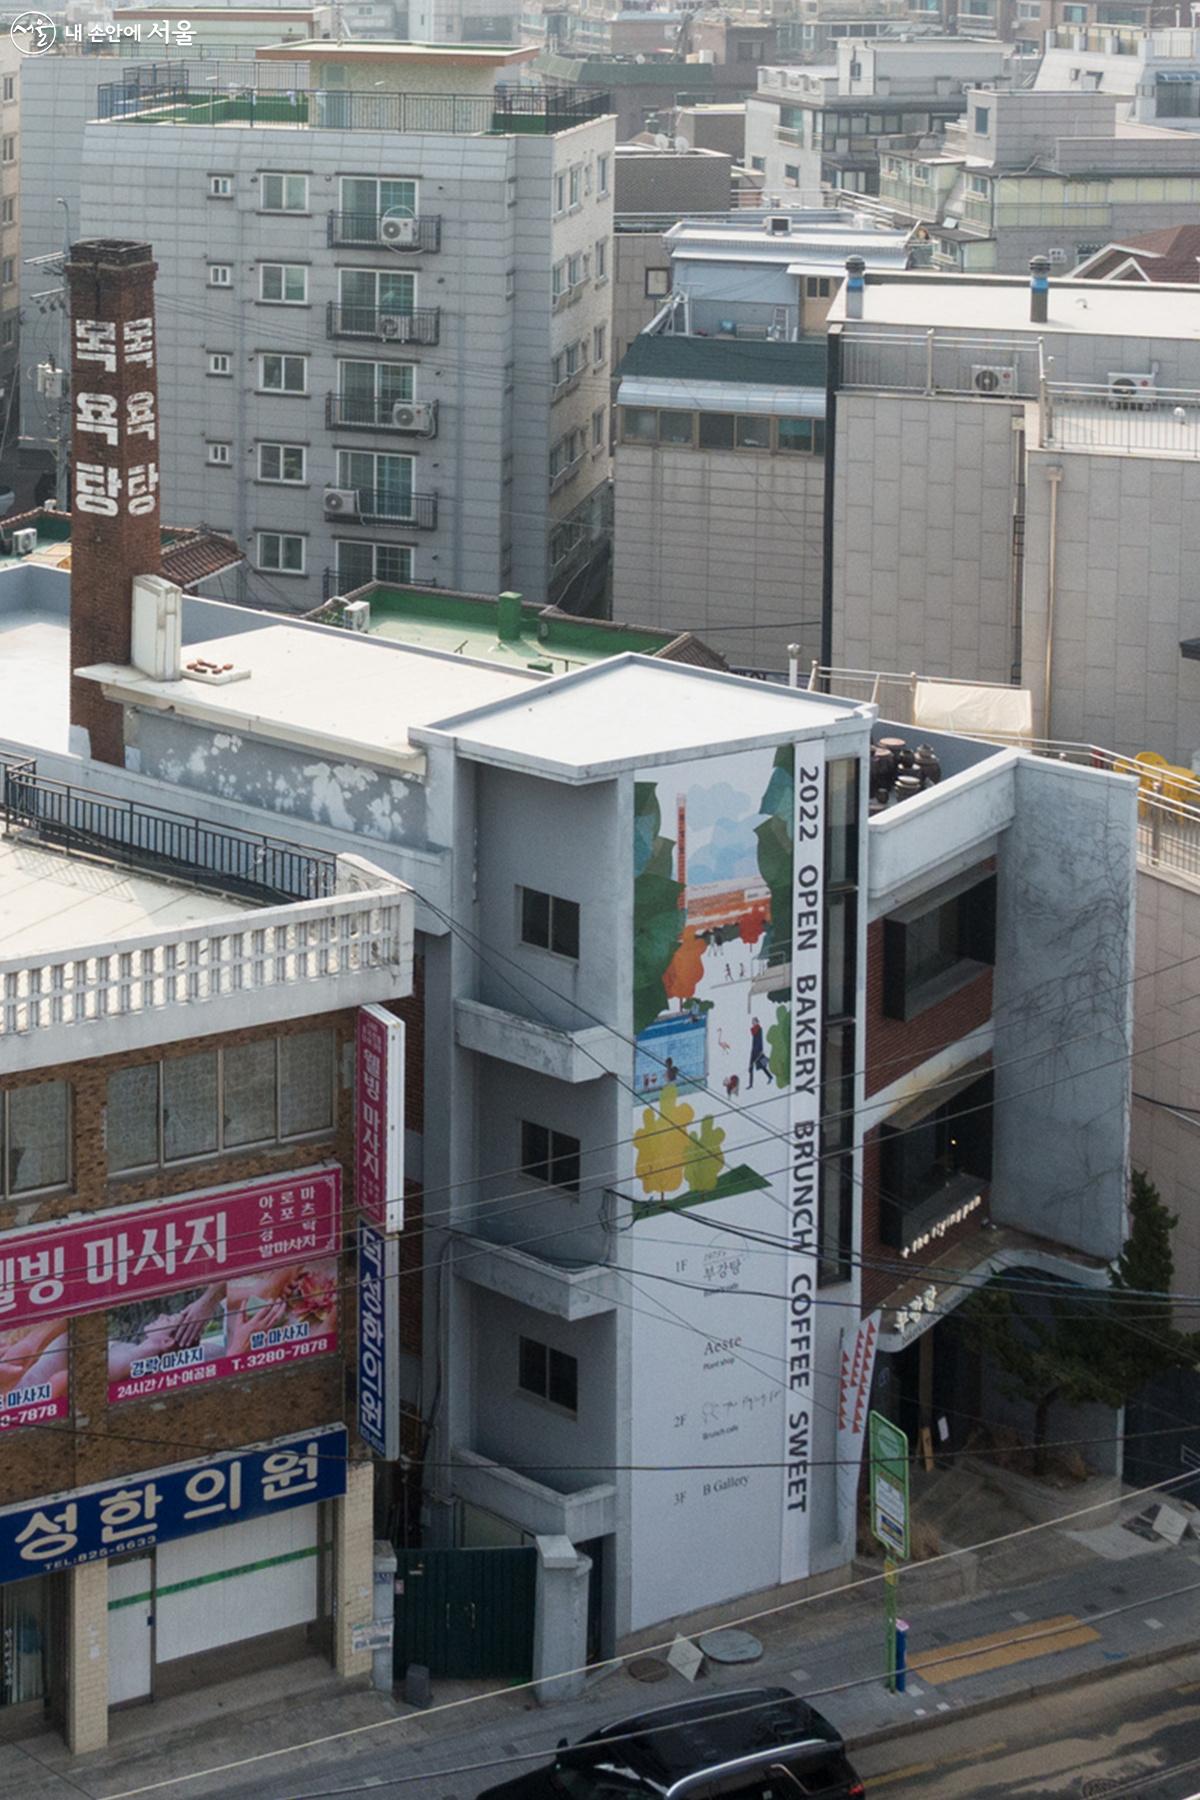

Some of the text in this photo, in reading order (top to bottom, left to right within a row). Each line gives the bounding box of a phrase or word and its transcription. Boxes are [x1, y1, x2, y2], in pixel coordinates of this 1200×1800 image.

[75, 318, 122, 517] 목욕탕
[123, 317, 159, 517] 목욕탕
[363, 1102, 380, 1180] 마사지
[787, 766, 820, 1512] 2022 OPEN BAKERY BRUNCH COFFEE SWEET
[83, 1211, 228, 1287] 마사지
[162, 1348, 204, 1370] 마사지
[268, 1322, 309, 1345] 마사지
[8, 1384, 51, 1407] 마사지
[703, 1483, 711, 1496] B
[713, 1475, 749, 1493] Gallery
